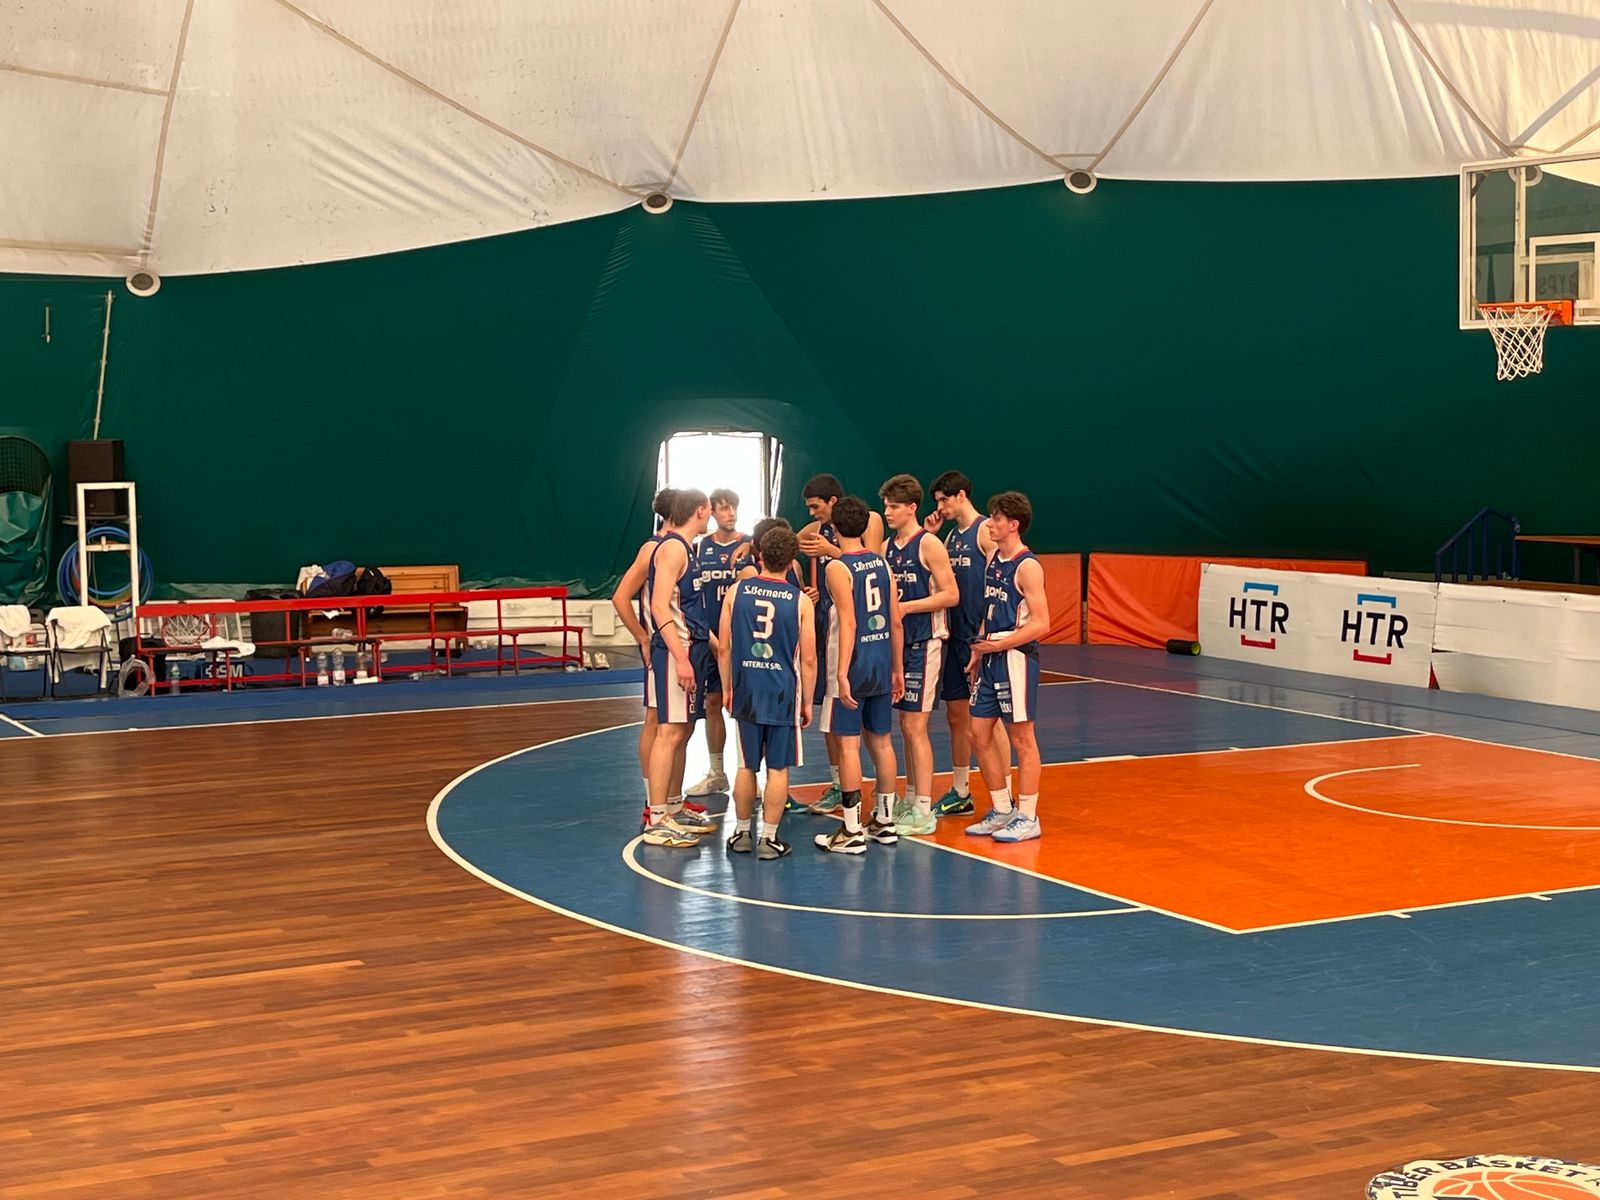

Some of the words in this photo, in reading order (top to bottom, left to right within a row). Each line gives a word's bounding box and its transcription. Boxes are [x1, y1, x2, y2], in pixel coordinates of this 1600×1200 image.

[865, 572, 881, 612] 6
[752, 599, 775, 639] 3
[1229, 597, 1290, 634] HTR
[1341, 610, 1409, 649] HTR
[1438, 1159, 1587, 1178] BASKET
